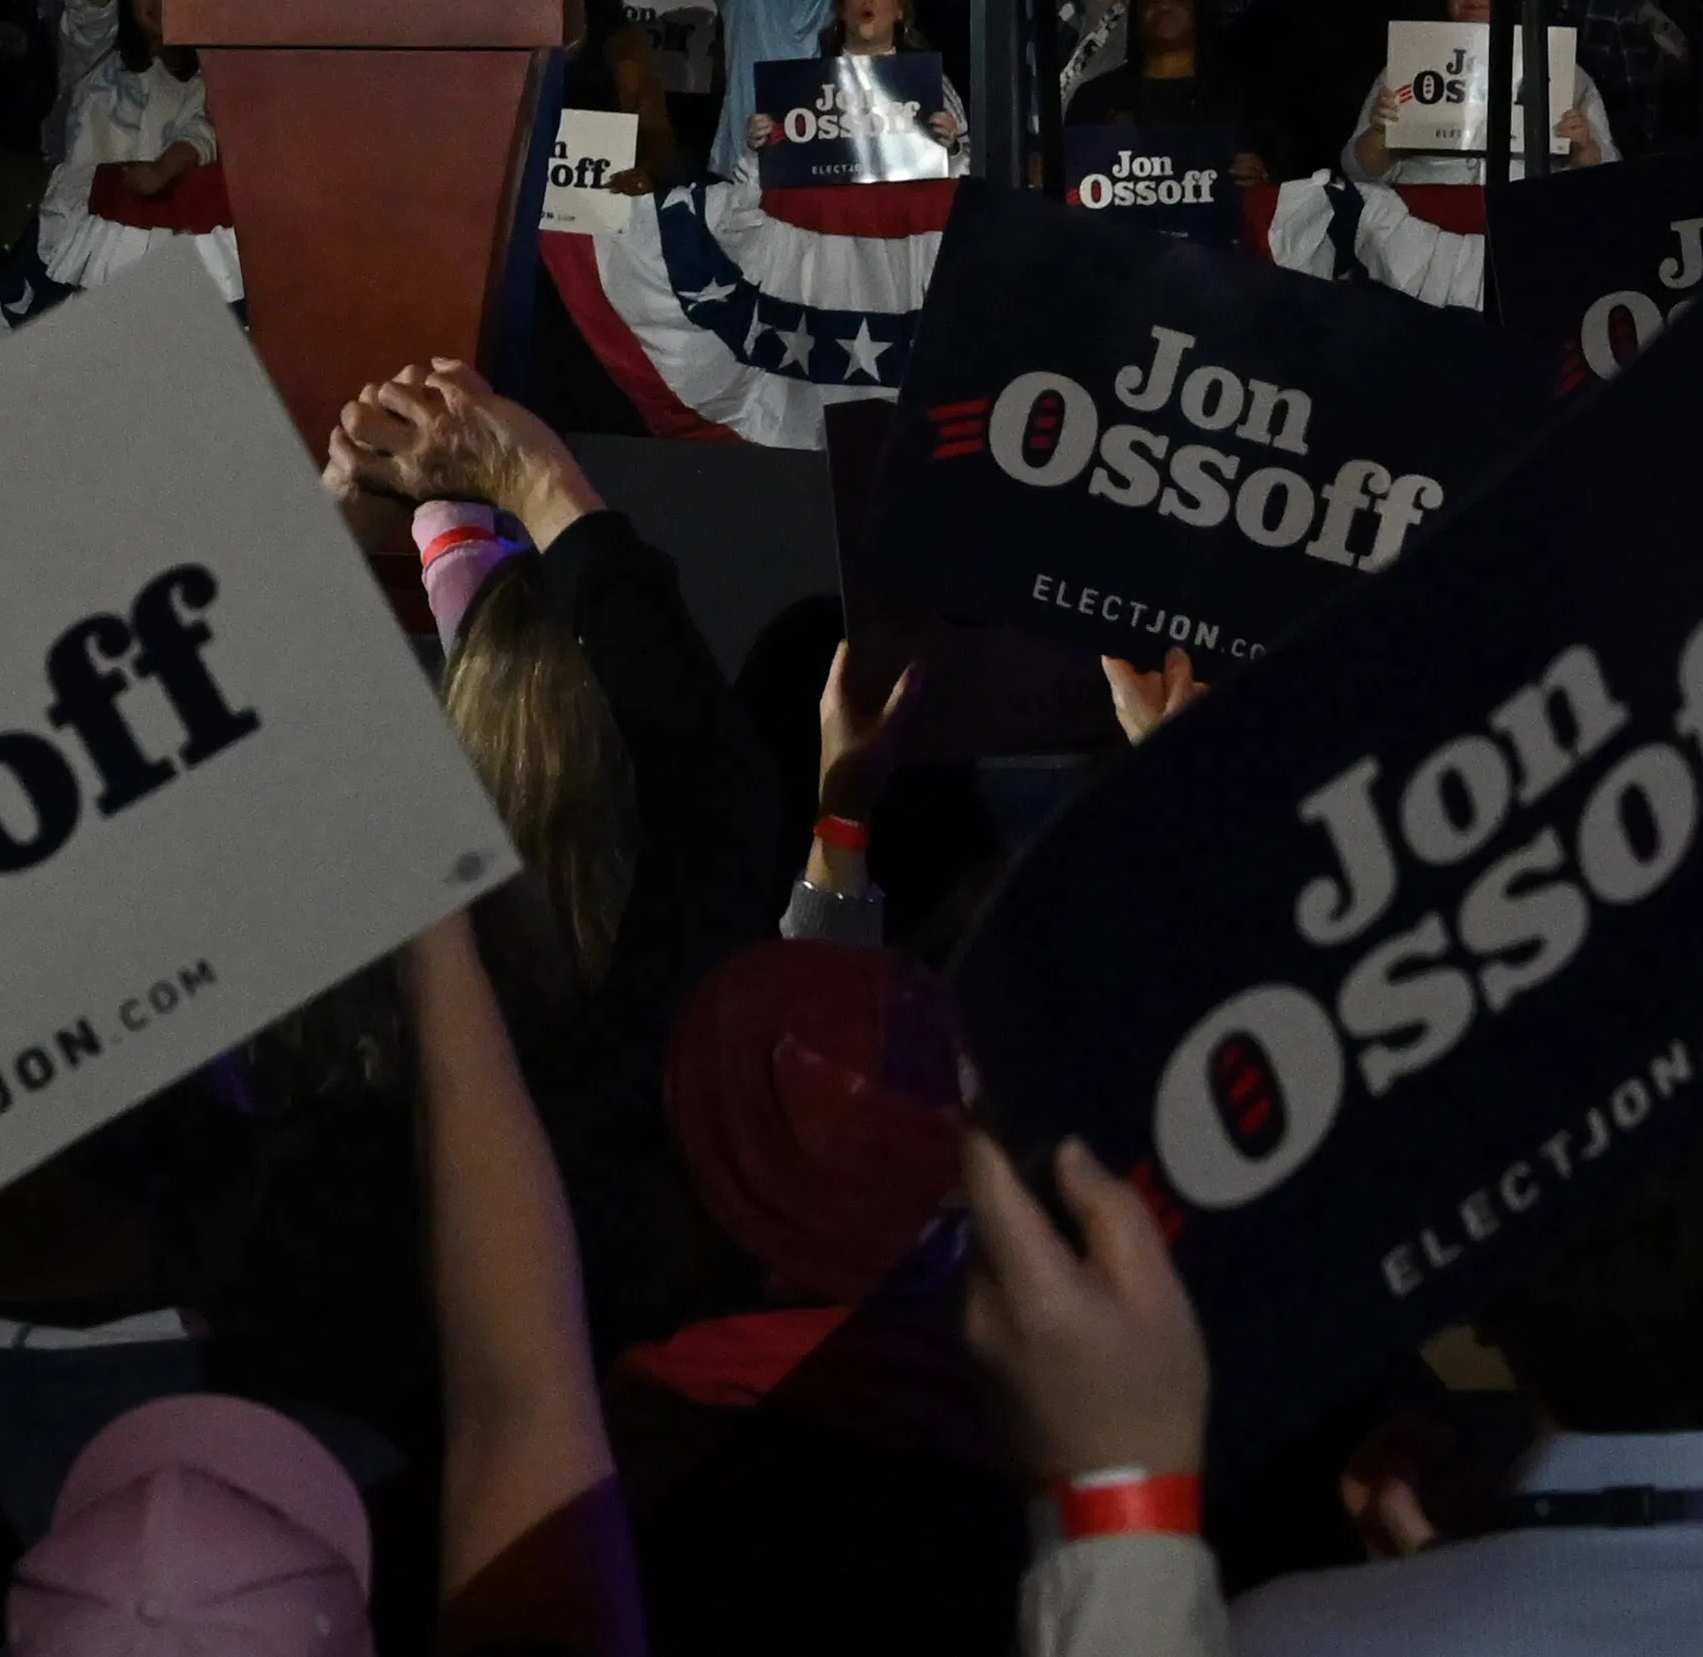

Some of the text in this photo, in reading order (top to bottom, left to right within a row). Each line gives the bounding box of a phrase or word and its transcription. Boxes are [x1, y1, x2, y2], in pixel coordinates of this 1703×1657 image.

[1078, 168, 1218, 210] Ossoff
[1110, 149, 1174, 178] Jon
[1112, 321, 1317, 459] Jon
[985, 369, 1446, 579] Ossoff
[1030, 572, 1270, 663] ELECTJON.CO
[1291, 641, 1635, 952] Jon
